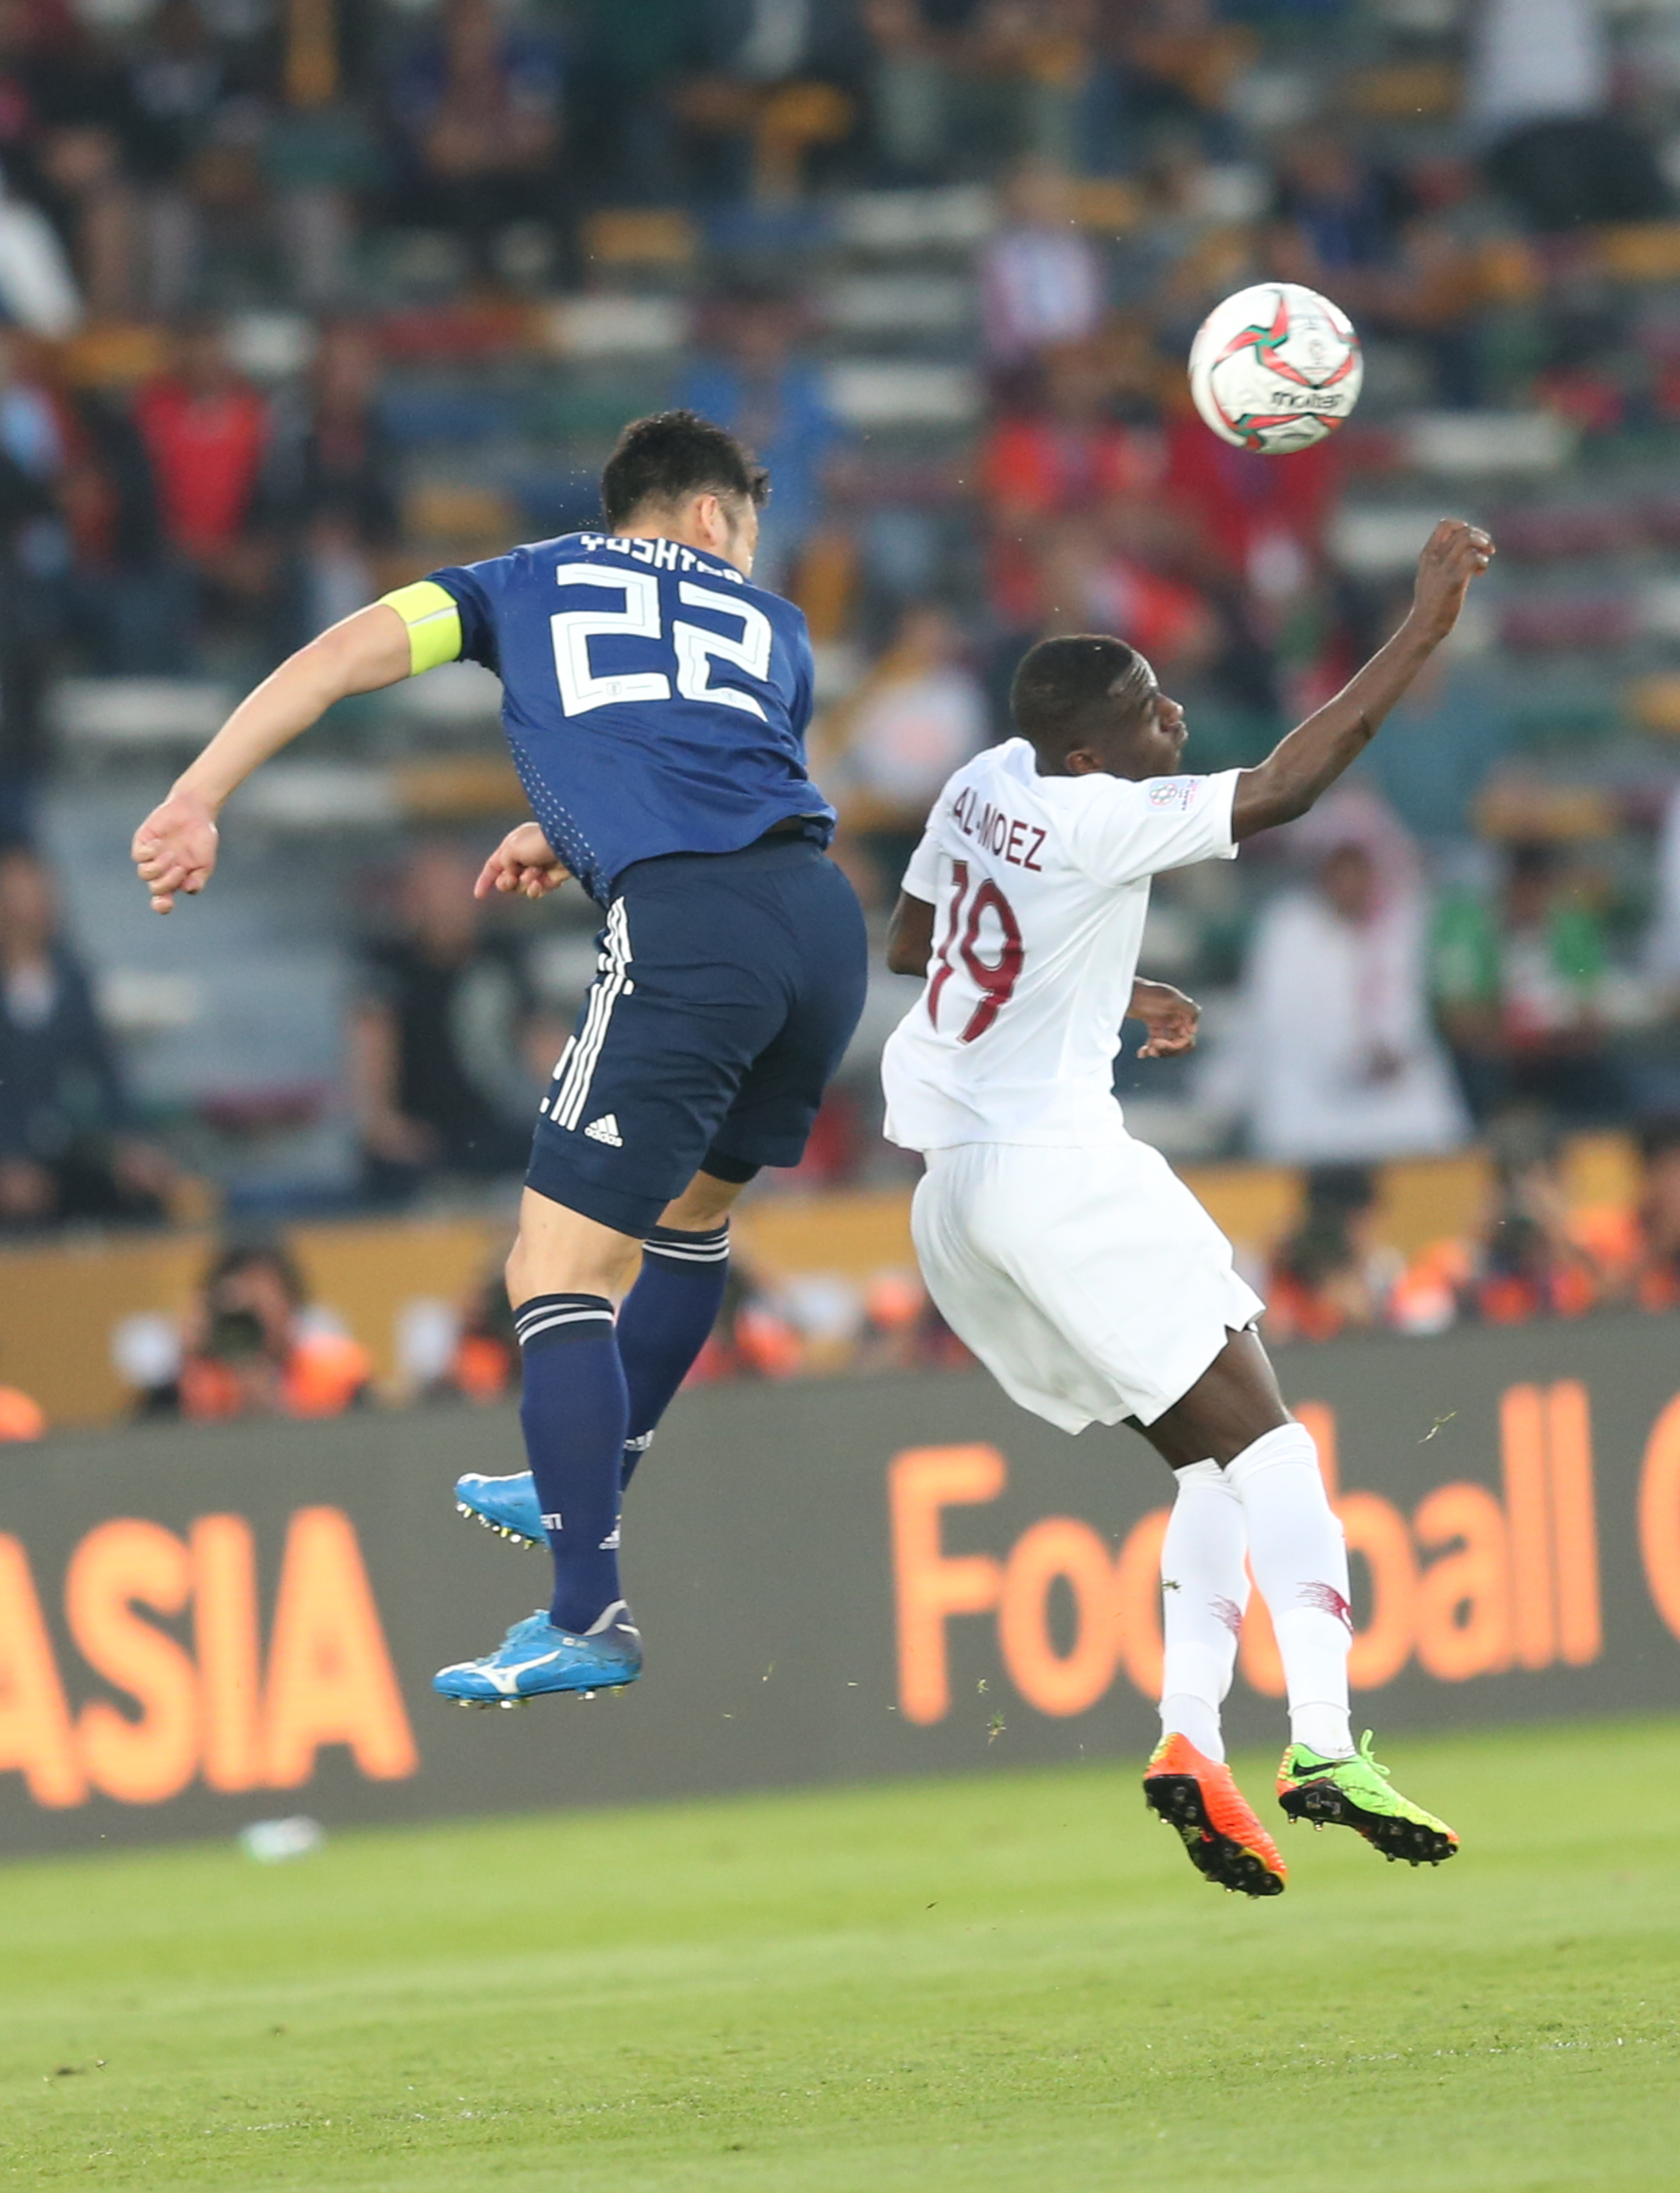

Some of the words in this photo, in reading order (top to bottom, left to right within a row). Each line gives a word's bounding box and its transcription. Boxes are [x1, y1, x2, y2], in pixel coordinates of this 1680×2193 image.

[550, 563, 771, 722] 22
[928, 860, 1024, 1044] 19
[584, 1126, 623, 1147] adidas
